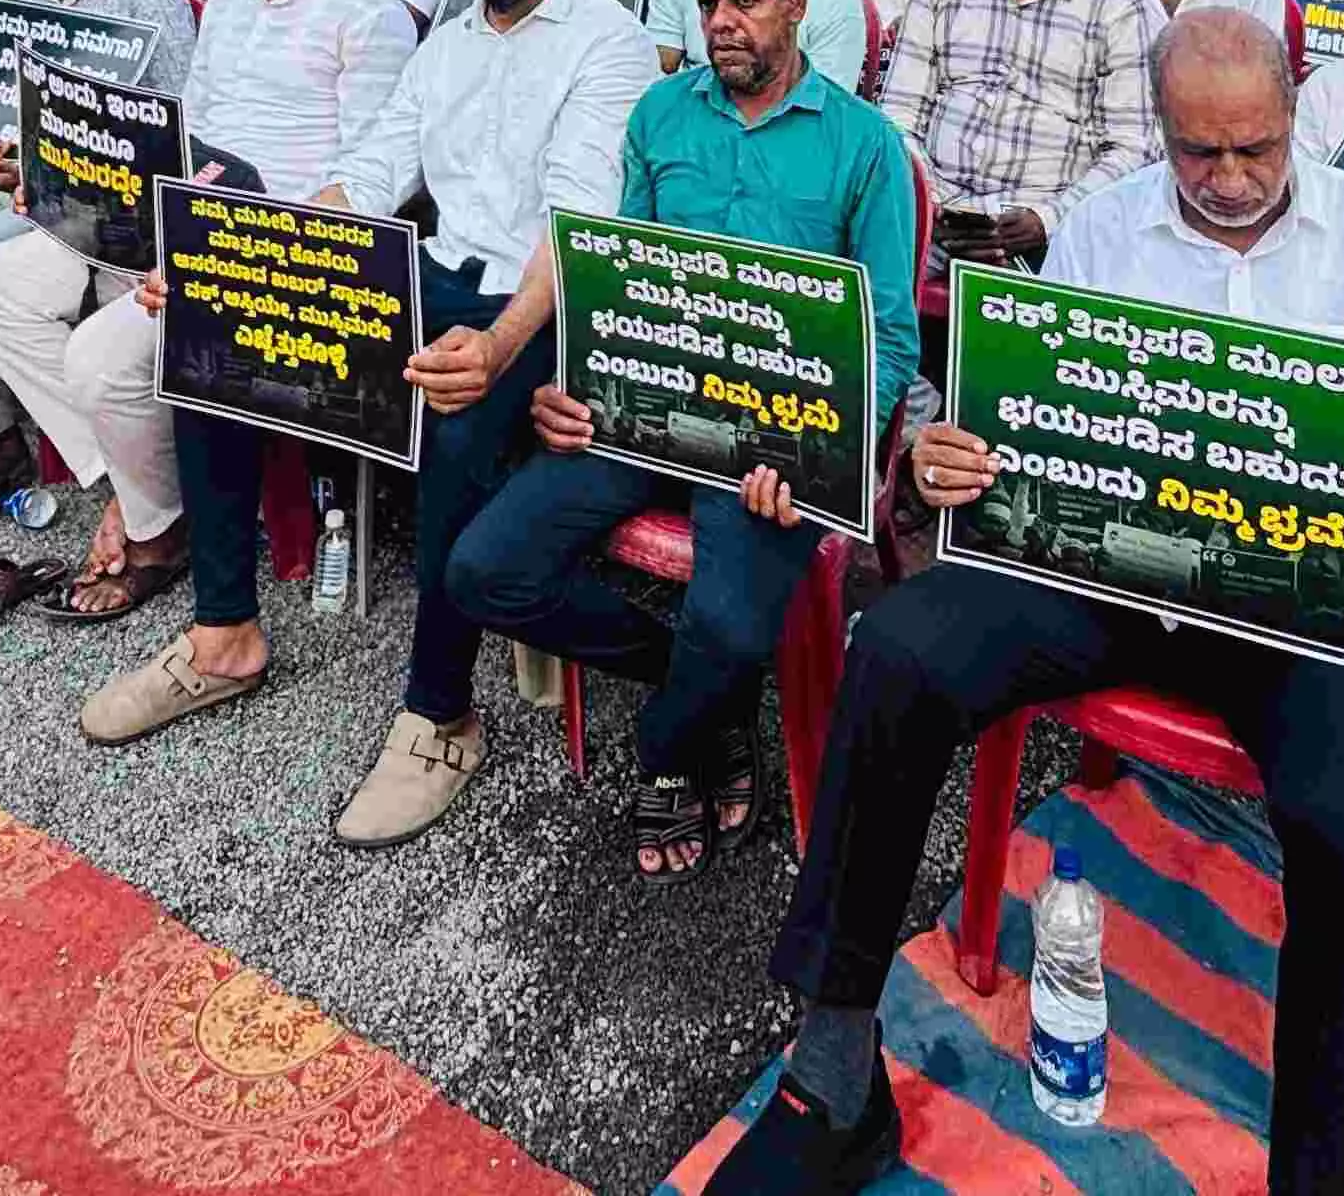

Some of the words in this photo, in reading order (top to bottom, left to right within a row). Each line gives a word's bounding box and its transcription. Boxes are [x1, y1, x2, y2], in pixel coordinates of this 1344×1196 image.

[40, 108, 135, 162] ಮುಂದೆಯೂ
[106, 93, 168, 127] ಇಂದು
[191, 198, 235, 228] ನಮ್ಮ
[305, 220, 374, 248] ಮದರಸ
[208, 229, 289, 267] ಮಾತ್ರವಲ್ಲ
[628, 237, 730, 281] ತಿದ್ದುಪಡಿ
[736, 261, 845, 303] ಮೂಲಕ
[625, 277, 793, 347] ಮುಸ್ಲಿಮರನ್ನು
[981, 294, 1064, 349] ವಕ್ಫ್
[1067, 308, 1216, 365] ತಿದ್ದುಪಡಿ
[591, 309, 725, 359] ಭಯಪಡಿಸ
[732, 343, 834, 387] ಬಹುದು
[587, 348, 696, 394] ಎಂಬುದು
[703, 373, 771, 424] ನಿಮ್ಮ
[772, 392, 840, 433] ಭ್ರಮೆ
[1056, 356, 1295, 449] ಮುಸ್ಲಿಮರನ್ನು
[998, 395, 1195, 461] ಭಯಪಡಿಸ
[995, 443, 1146, 500] ಎಂಬುದು
[1157, 478, 1256, 544] ನಿಮ್ಮ
